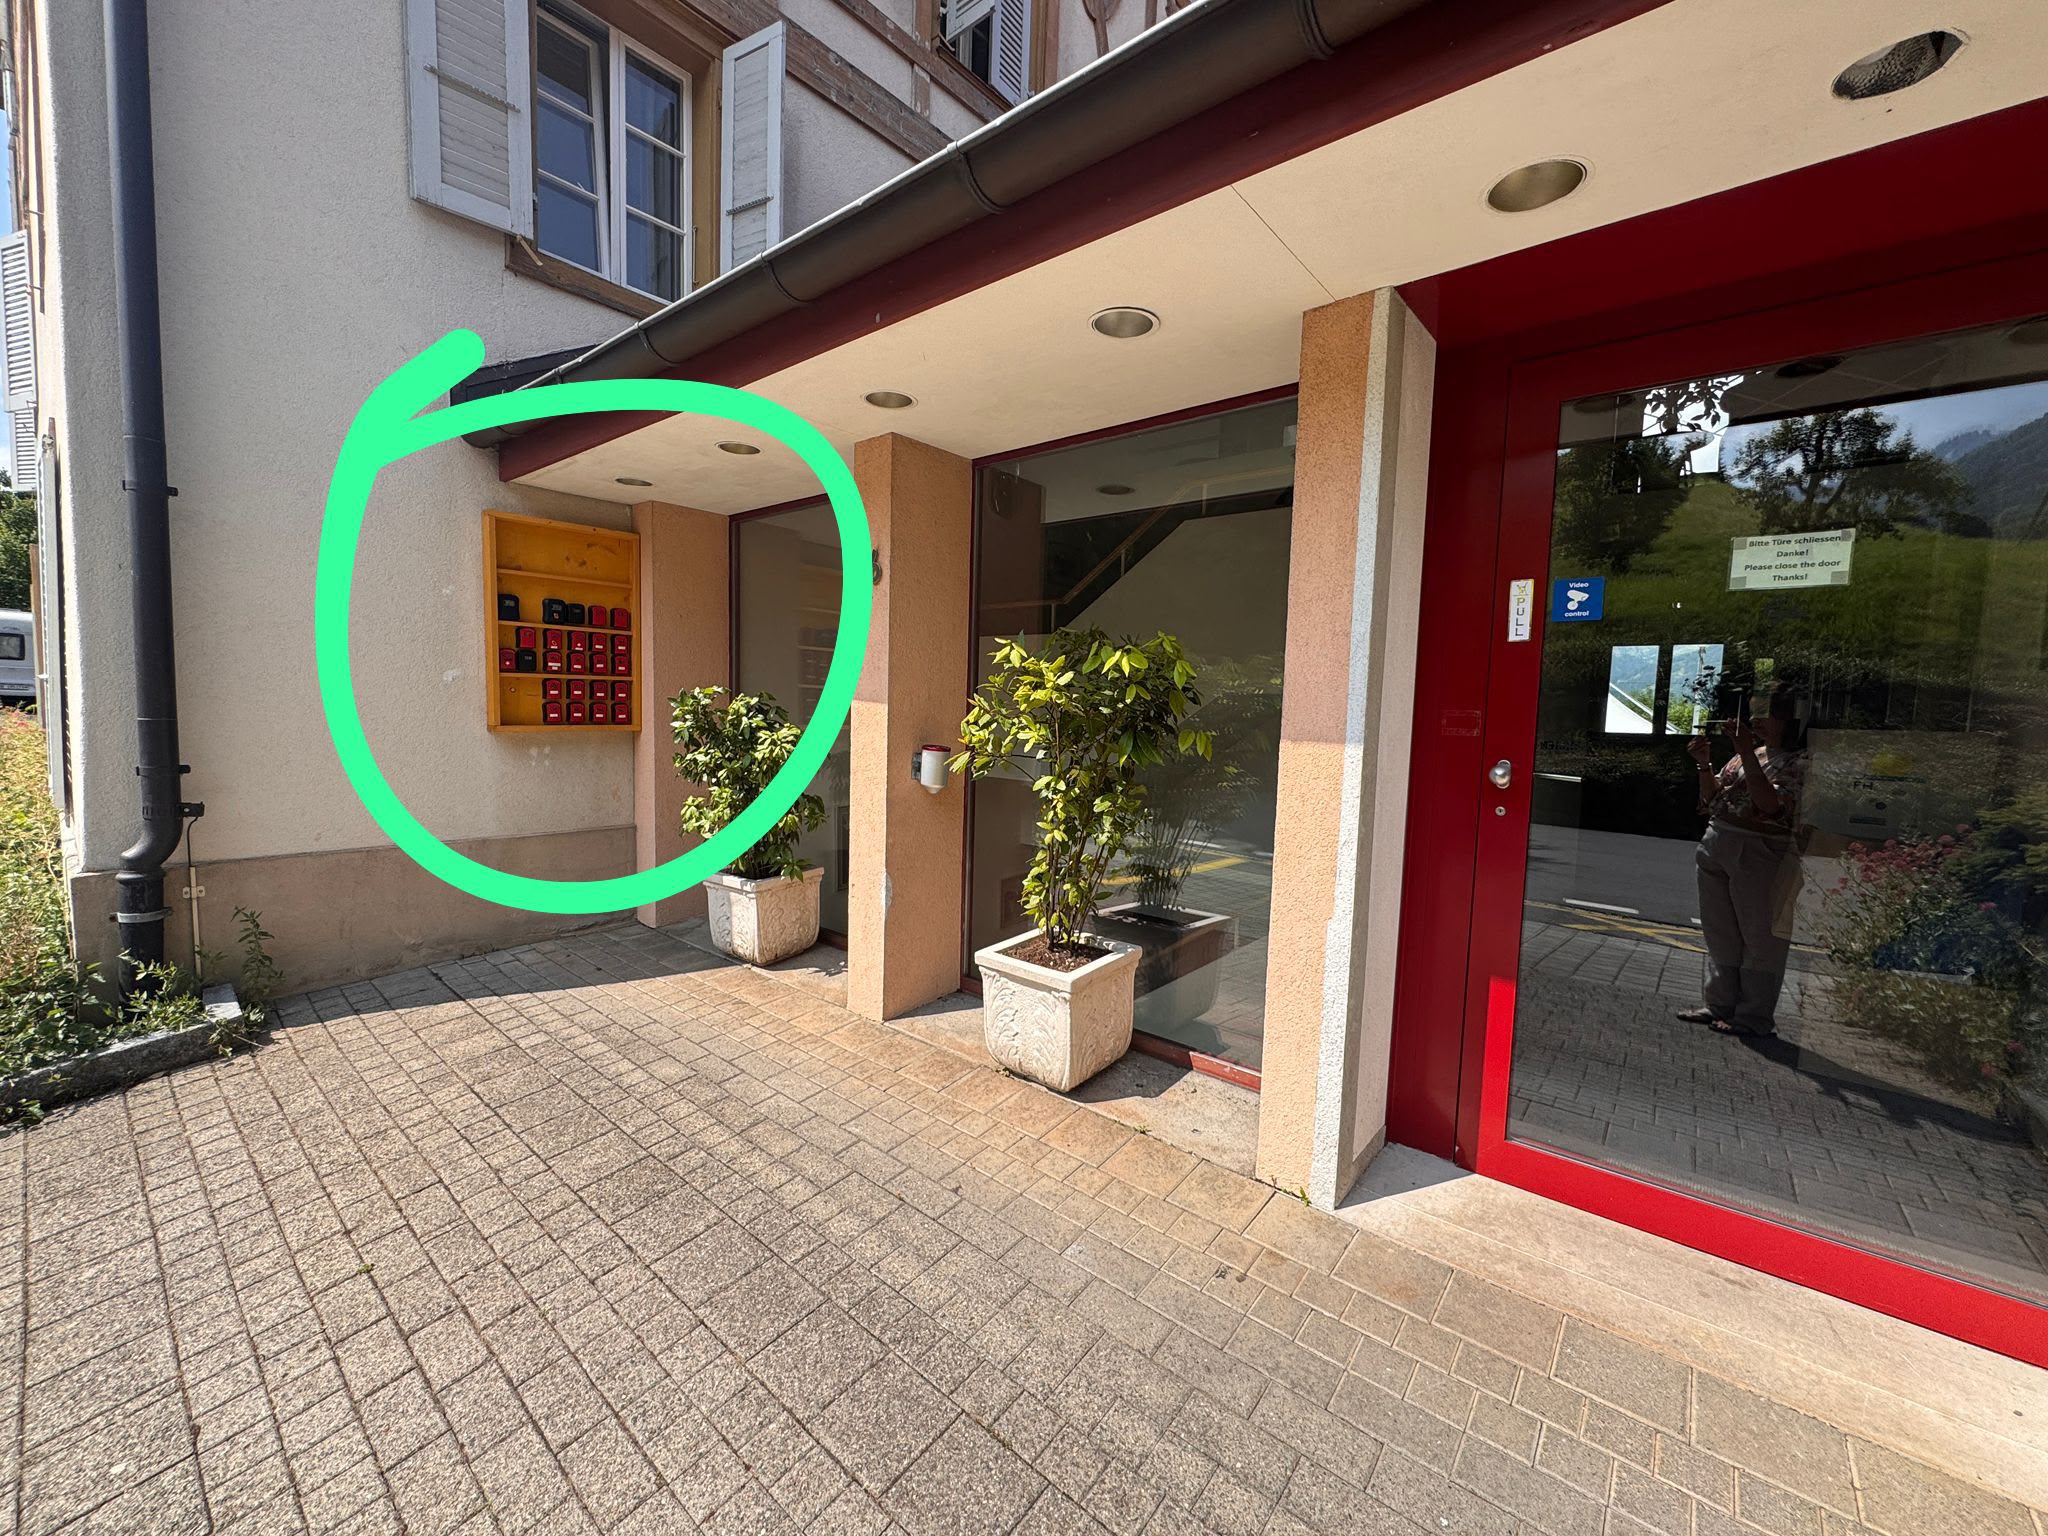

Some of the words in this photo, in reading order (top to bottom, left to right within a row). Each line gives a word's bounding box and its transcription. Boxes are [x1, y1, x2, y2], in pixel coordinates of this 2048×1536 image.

[1794, 536, 1841, 544] schliessen
[1776, 549, 1809, 557] Danke!
[1772, 573, 1808, 581] Thanks!
[1514, 597, 1526, 636] PULL
